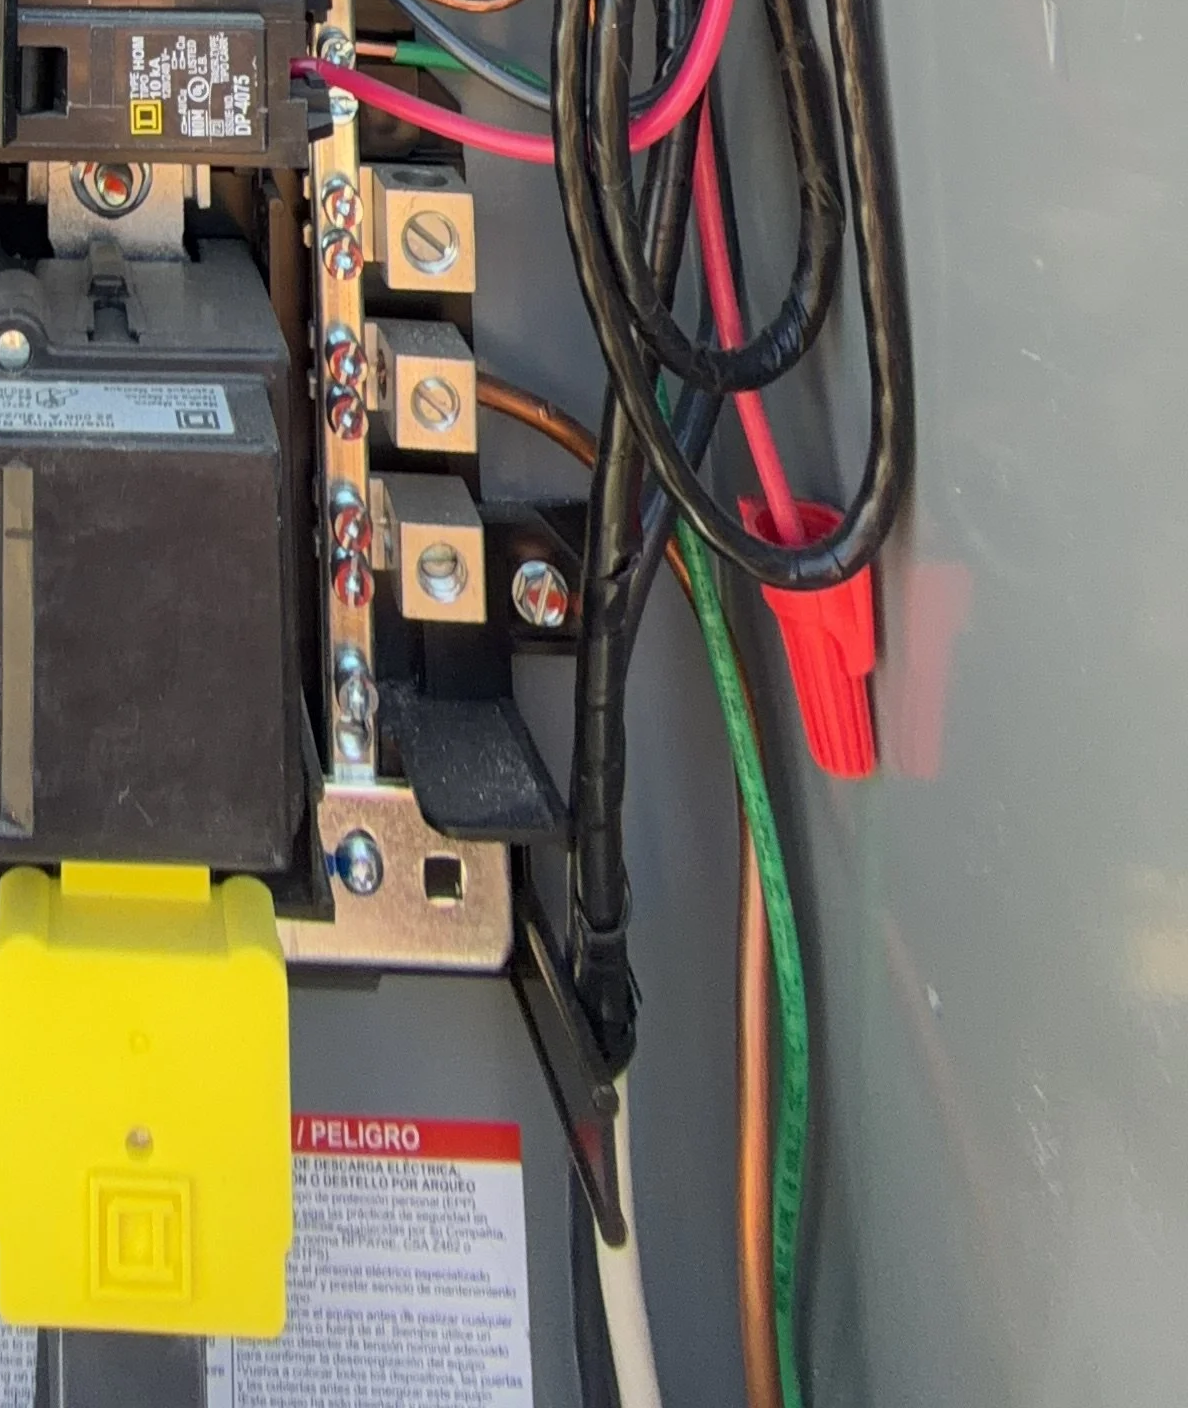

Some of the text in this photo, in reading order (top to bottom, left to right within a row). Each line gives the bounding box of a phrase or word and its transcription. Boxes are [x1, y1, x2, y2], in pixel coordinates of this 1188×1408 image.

[130, 36, 144, 98] TYPE HOM
[187, 40, 197, 74] LISTED
[149, 57, 161, 99] 10 kA
[233, 75, 251, 135] DP-4075
[312, 1120, 420, 1151] PELIGRO
[314, 1159, 382, 1174] DESCARGA
[323, 1175, 389, 1190] DESTELLO
[392, 1178, 418, 1191] POR
[422, 1179, 476, 1194] ARQUEO
